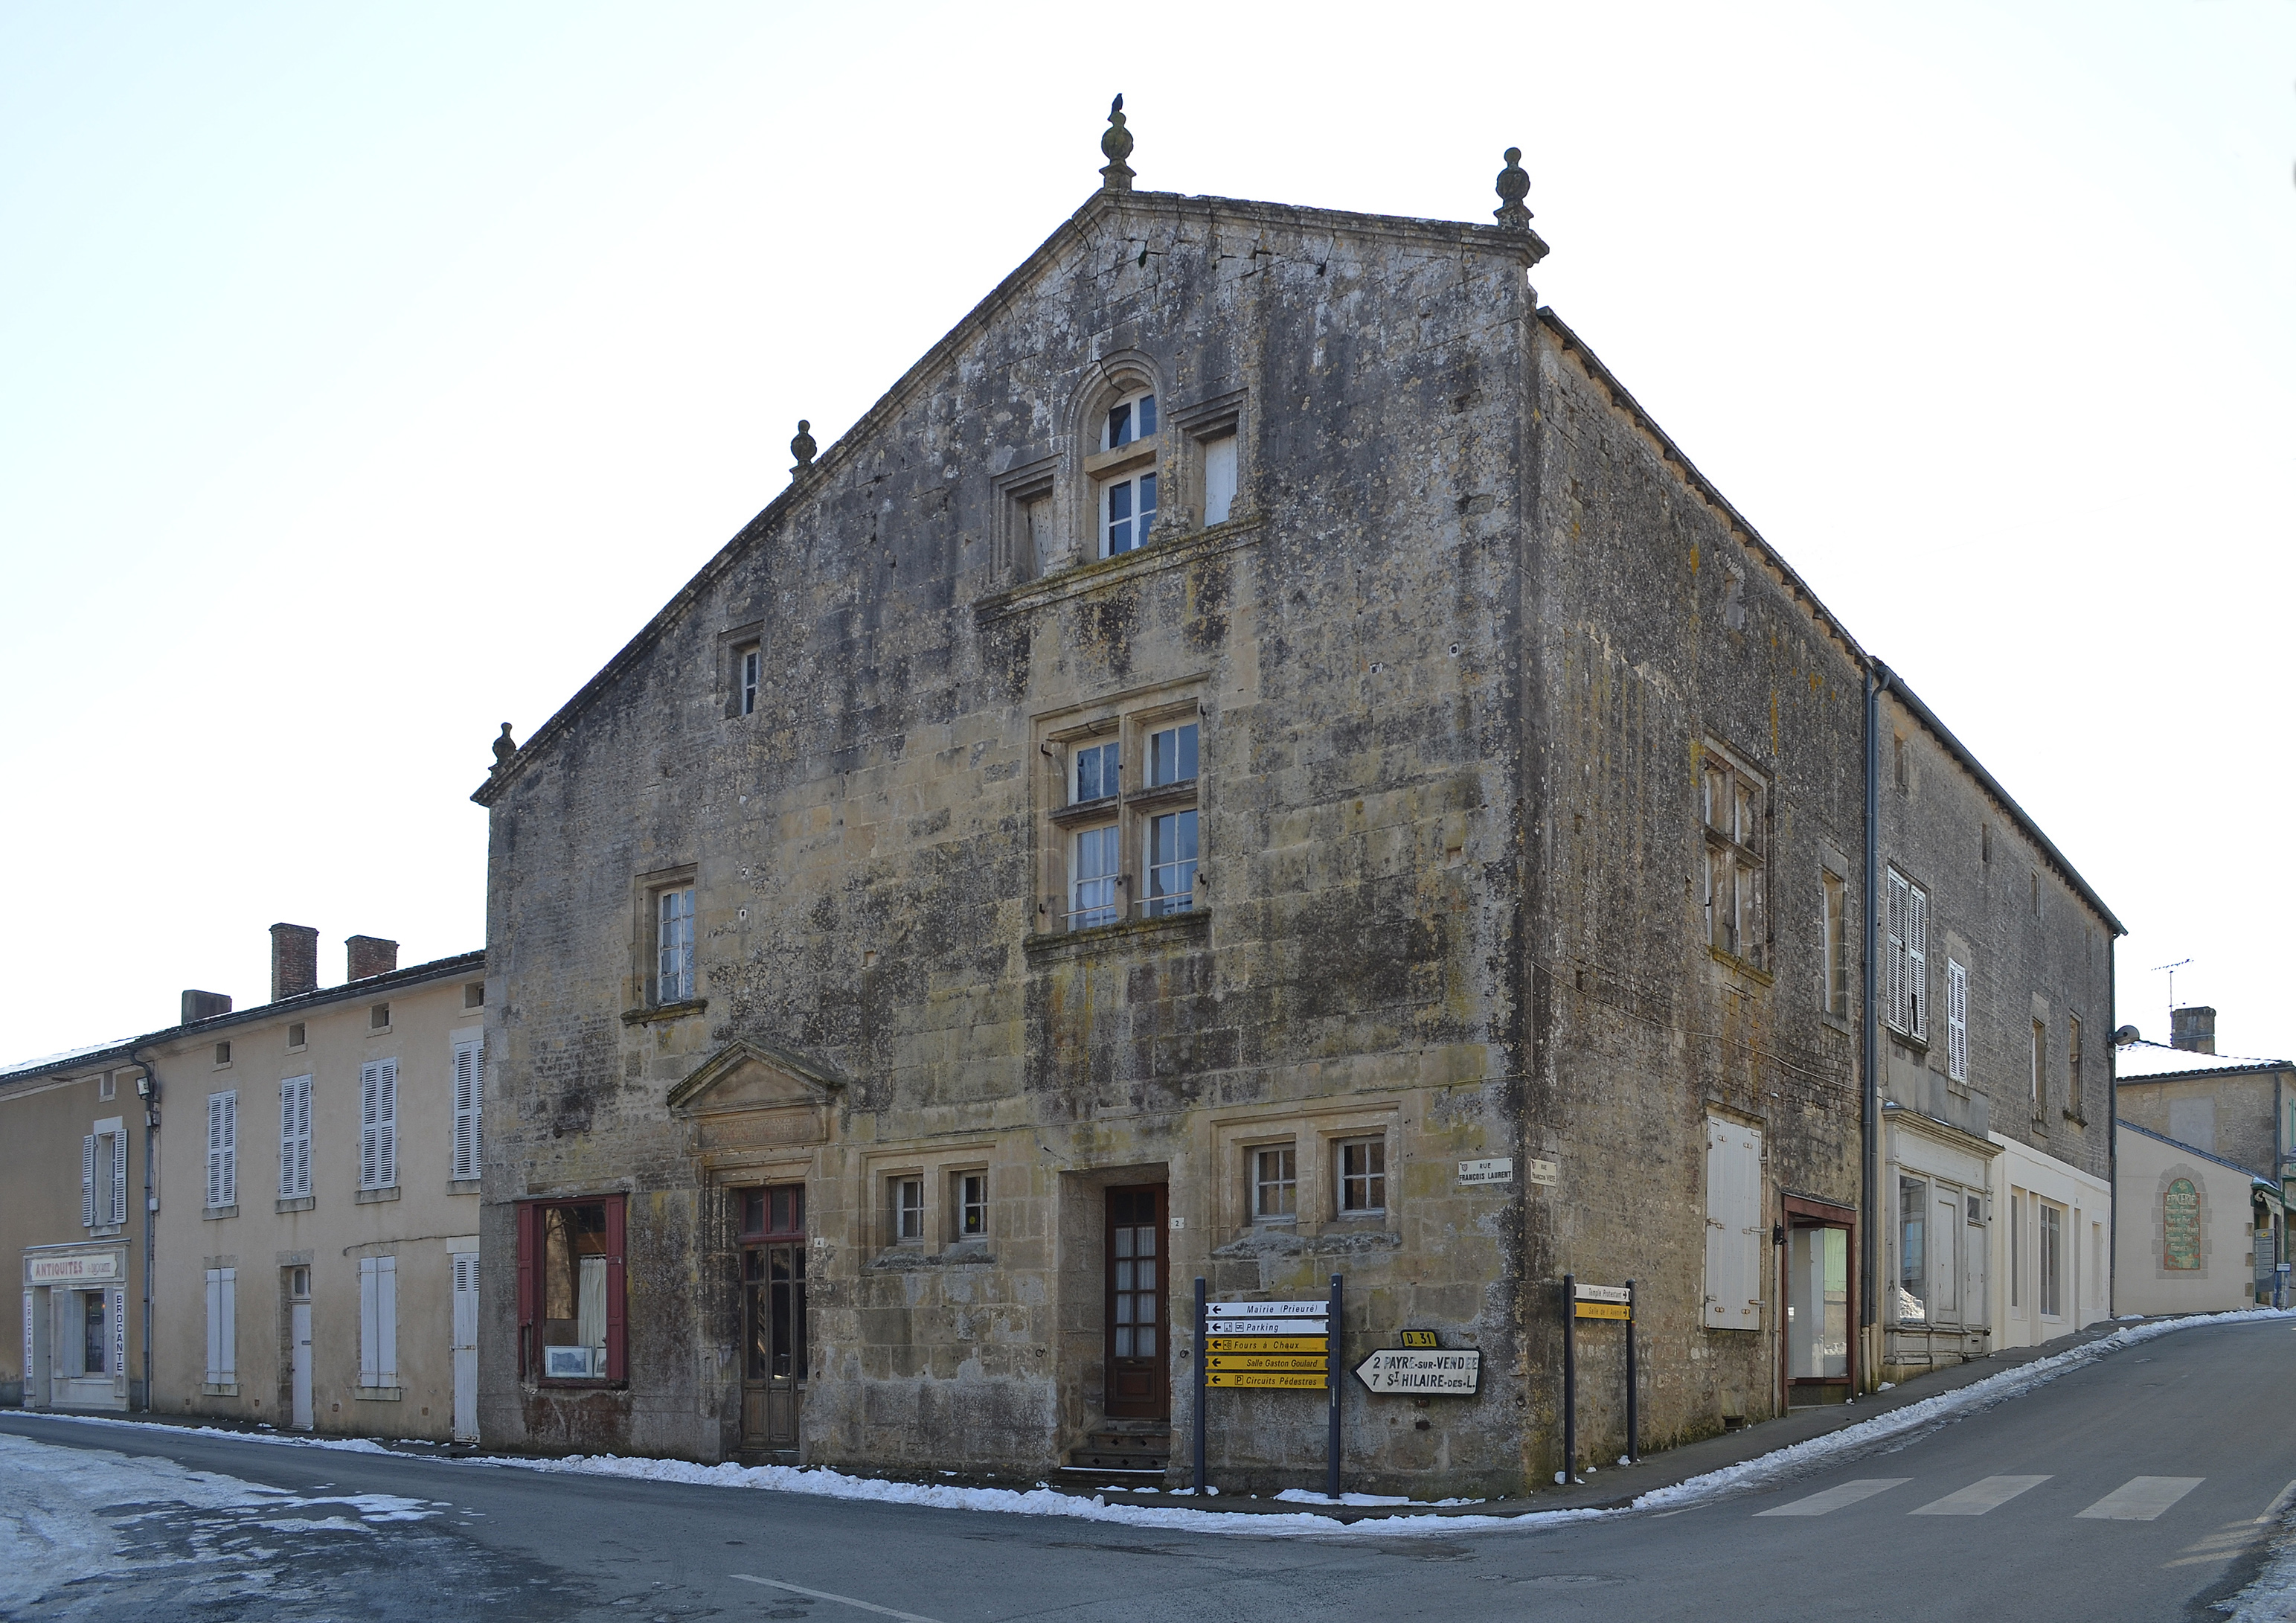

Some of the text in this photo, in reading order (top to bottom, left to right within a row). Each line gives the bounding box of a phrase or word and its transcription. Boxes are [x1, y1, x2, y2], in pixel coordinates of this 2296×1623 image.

[1459, 1171, 1512, 1182] FRANÇOIS LAURENT
[36, 1261, 83, 1277] ANTIQUITES
[1588, 1287, 1602, 1299] Temple
[1246, 1304, 1318, 1313] Mairie (Prieuré)
[1246, 1323, 1279, 1333] Parking
[1234, 1341, 1257, 1349] Fours
[1273, 1340, 1300, 1349] Chaux
[1246, 1359, 1318, 1368] Salle Gaston Goulard
[1373, 1356, 1381, 1369] 2
[1246, 1377, 1275, 1385] Circuits
[1279, 1377, 1317, 1386] Pédestres
[1373, 1374, 1380, 1386] 7
